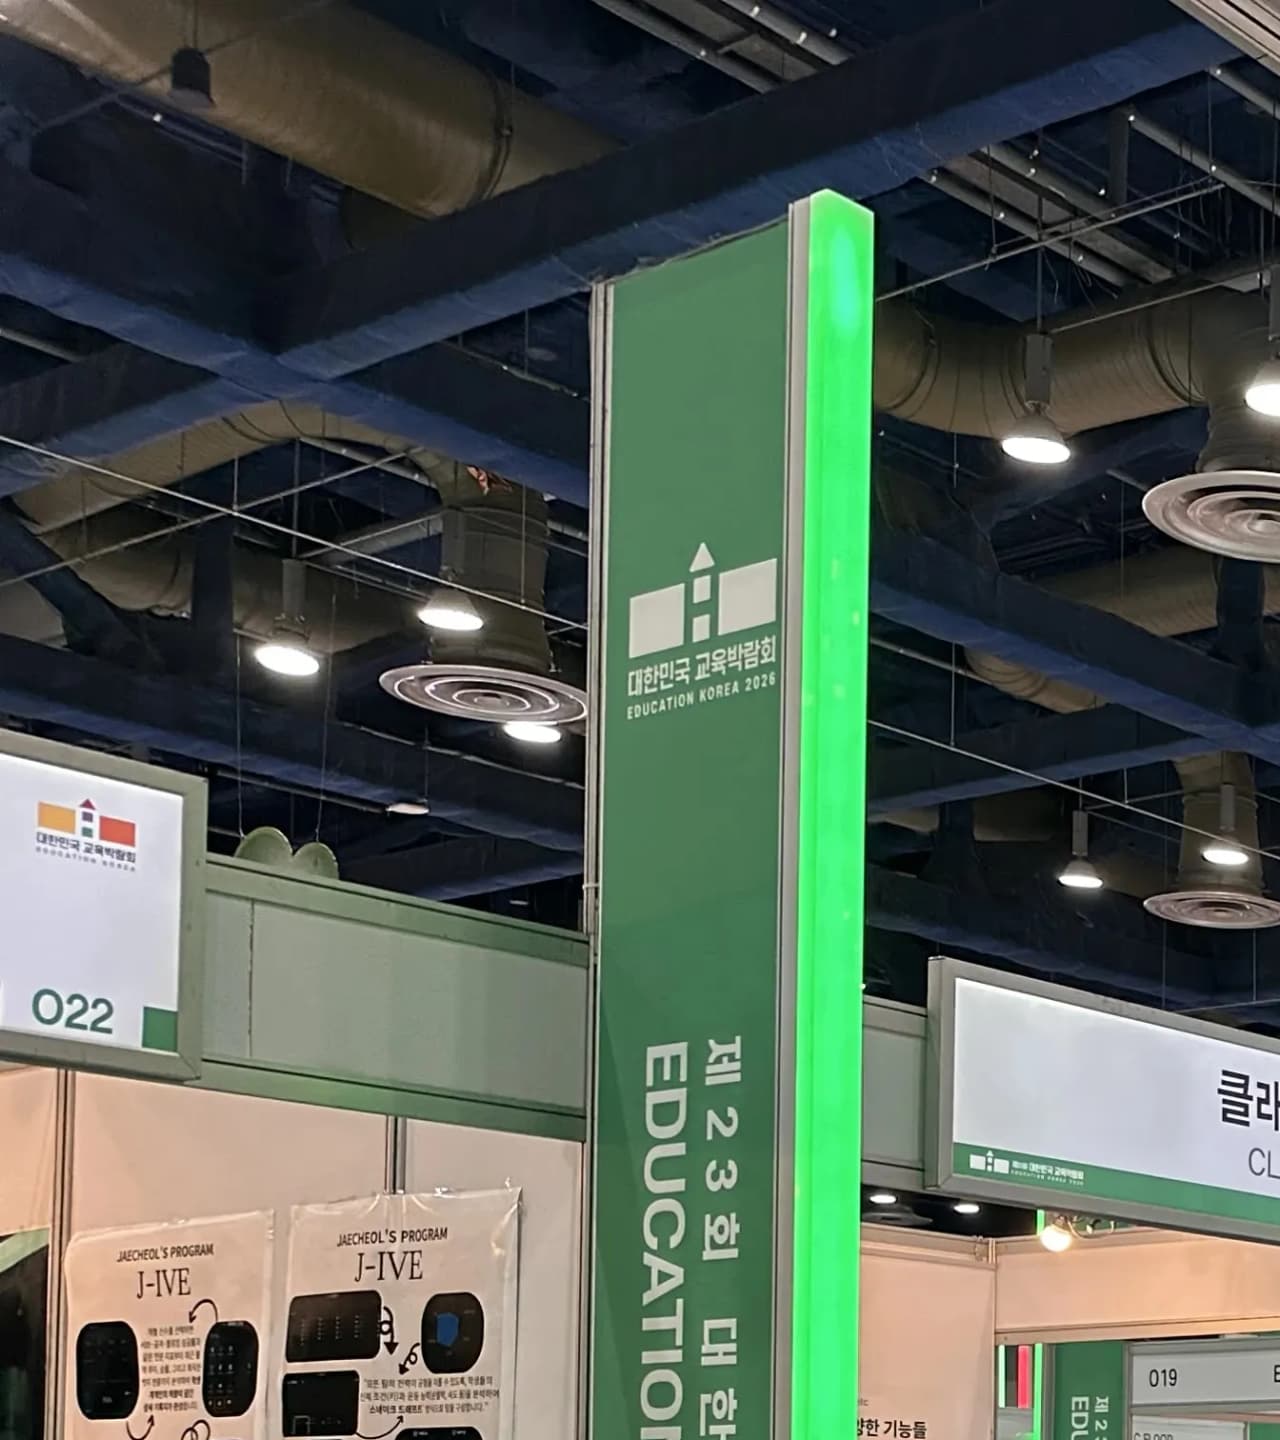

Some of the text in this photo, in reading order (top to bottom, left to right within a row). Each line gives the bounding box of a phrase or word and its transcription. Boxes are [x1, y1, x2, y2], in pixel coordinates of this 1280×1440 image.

[628, 634, 776, 697] 대한민국 교육박람회
[627, 671, 776, 720] EDUCATION KOREA 2026
[36, 831, 137, 863] 대한민국 교육박람회
[32, 988, 114, 1034] 022
[116, 1243, 214, 1263] JAECHEOL'S PROGRAM
[337, 1227, 448, 1248] JAECHEOL'S PROGRAM
[354, 1250, 423, 1282] J-IVE
[136, 1267, 192, 1299] J-IVE
[1149, 1369, 1178, 1387] 019
[883, 1419, 926, 1440] 기능들
